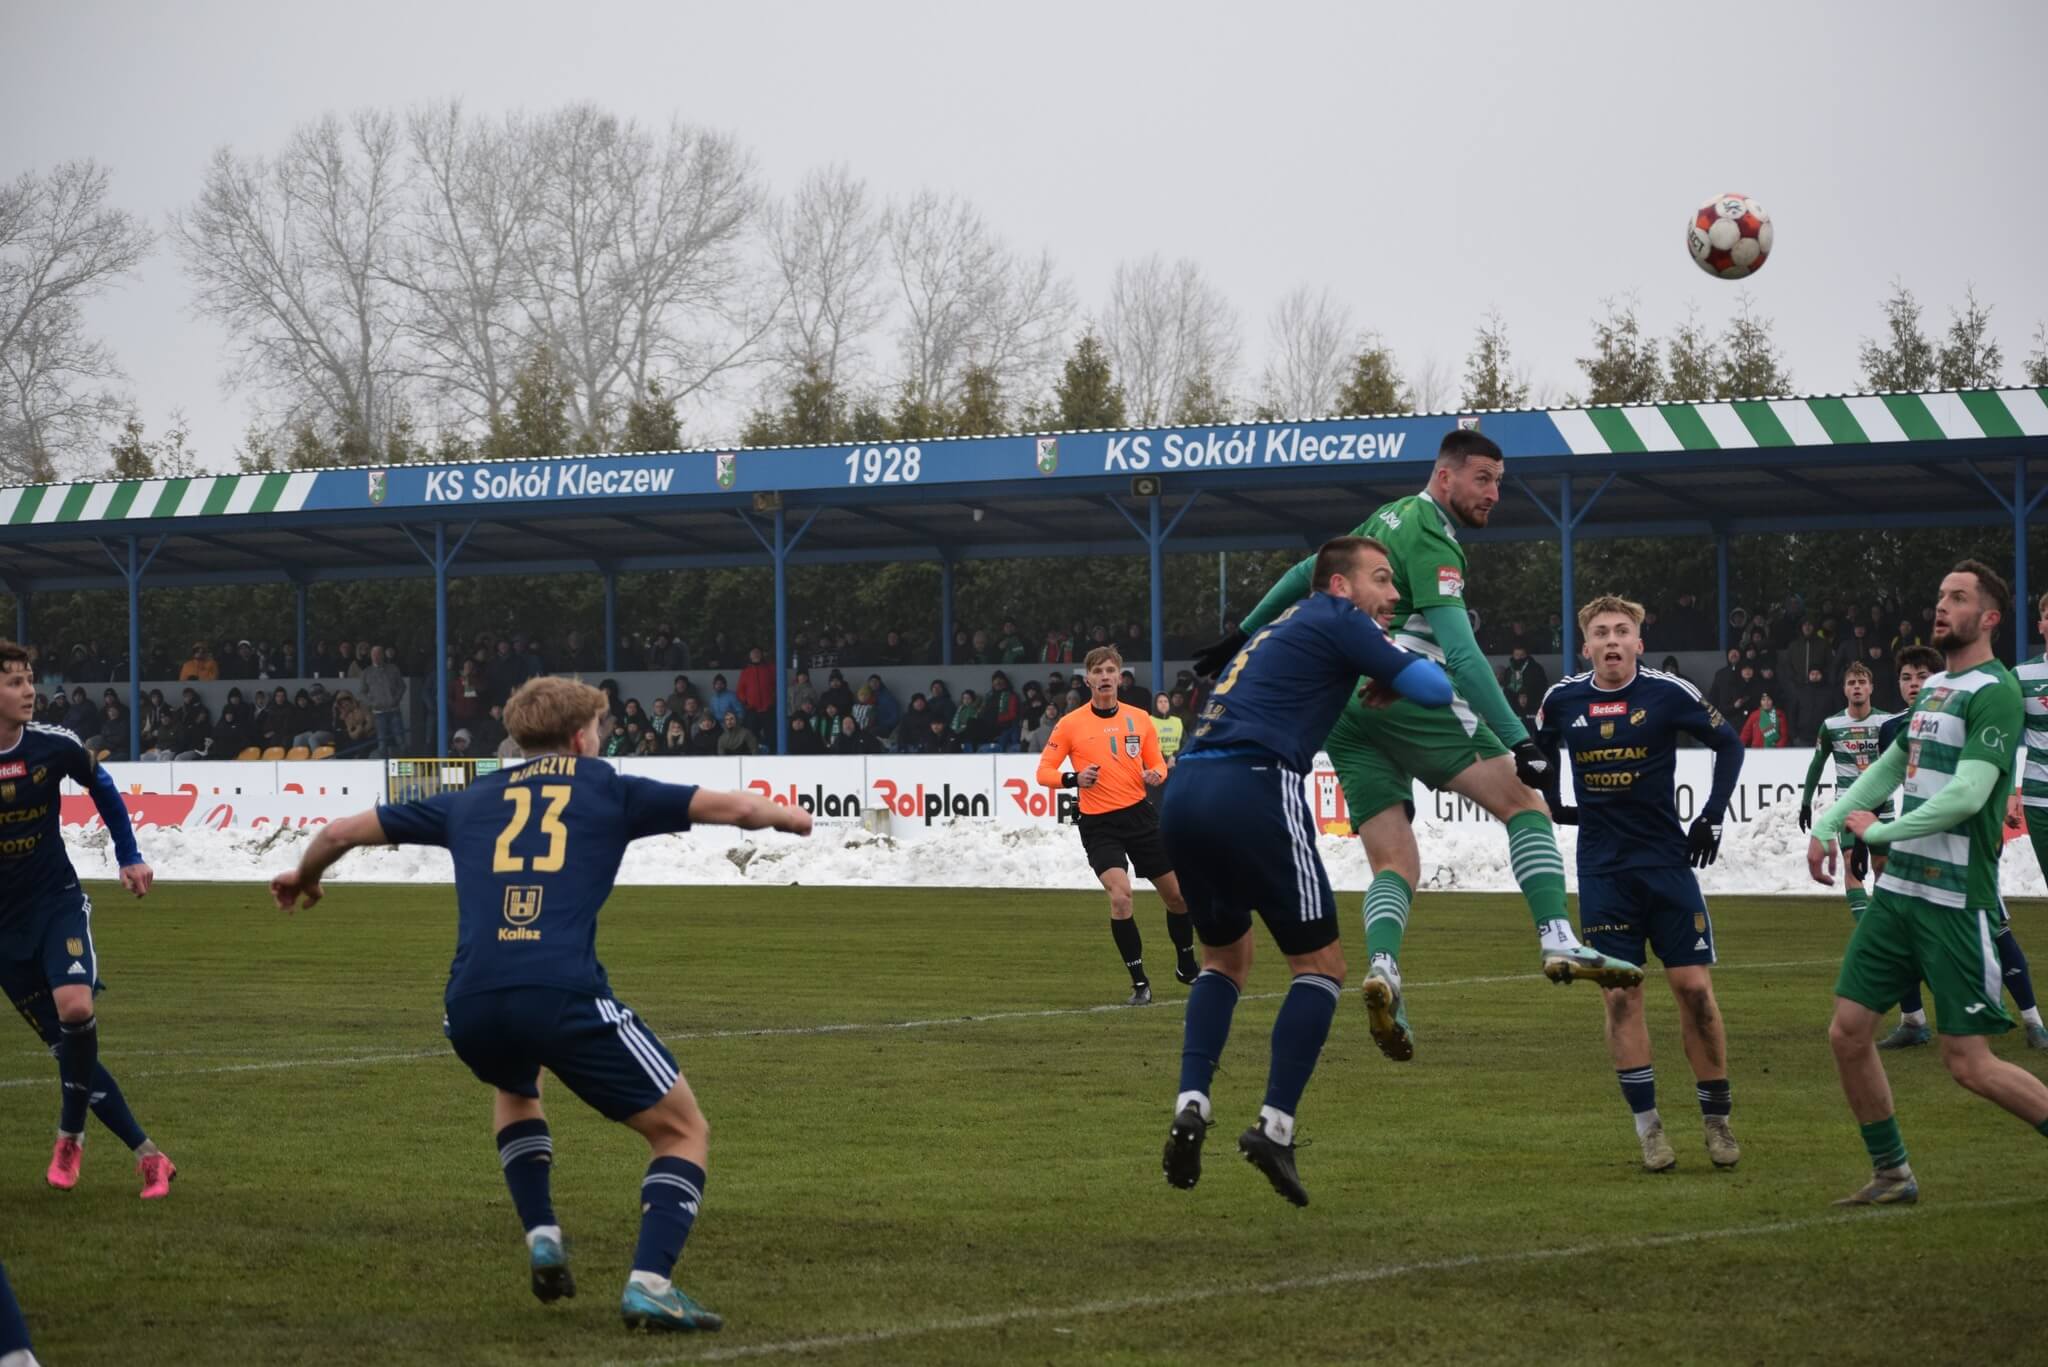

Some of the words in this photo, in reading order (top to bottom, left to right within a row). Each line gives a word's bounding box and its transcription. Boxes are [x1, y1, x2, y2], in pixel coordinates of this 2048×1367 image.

[845, 446, 921, 484] 1928
[1104, 434, 1152, 472] KS
[1161, 430, 1257, 468] Sokół
[1264, 428, 1407, 463] Kleczew
[425, 470, 464, 501] KS
[472, 465, 551, 499] Sokół
[557, 464, 675, 496] Kleczew
[1592, 704, 1625, 714] Betclic
[1575, 747, 1648, 763] ANTCZAK
[872, 778, 989, 826] Rolplan
[1003, 778, 1074, 823] Rolp
[492, 785, 572, 873] 23
[498, 927, 541, 941] Kalisz
